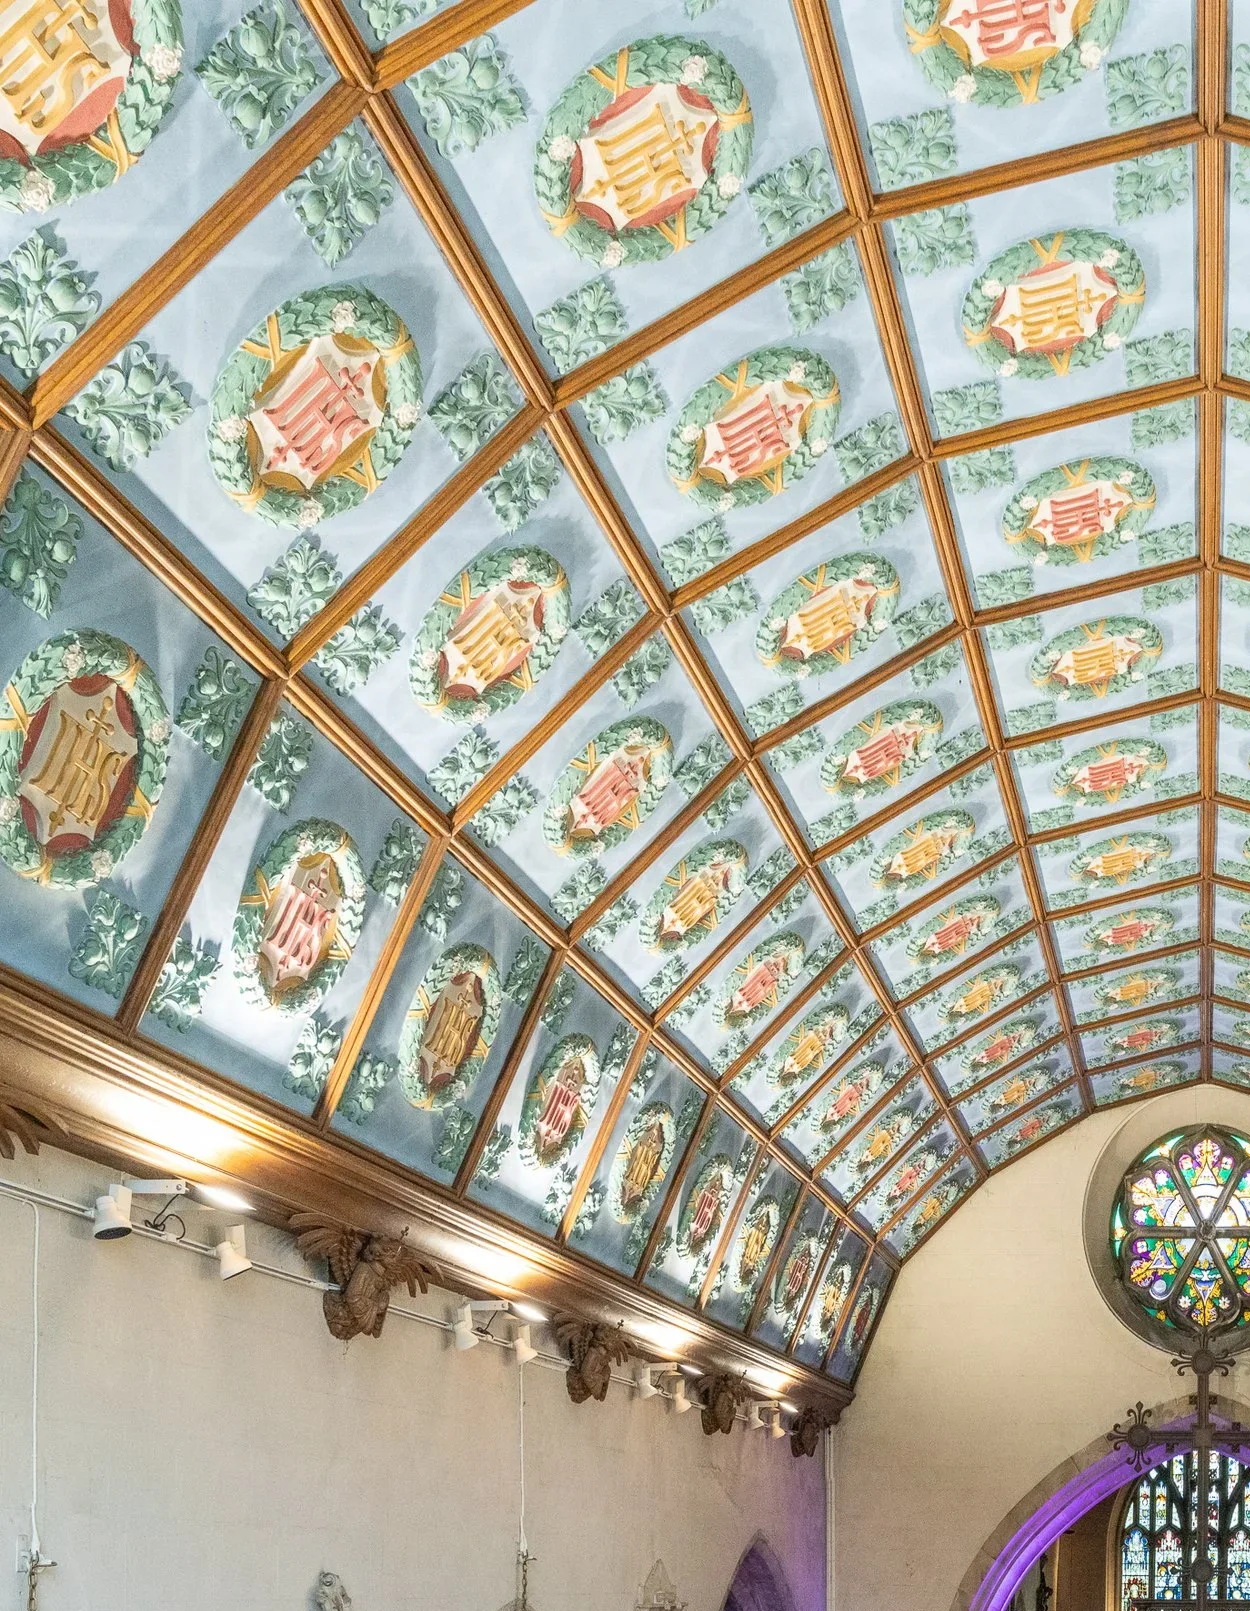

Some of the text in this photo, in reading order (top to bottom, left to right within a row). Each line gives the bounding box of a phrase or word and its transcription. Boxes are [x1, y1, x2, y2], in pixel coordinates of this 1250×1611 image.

[585, 103, 704, 214] IHS
[1006, 272, 1108, 351] IHS
[258, 355, 372, 475] IHS
[712, 393, 805, 475] IHS
[1033, 489, 1123, 542] IHS
[453, 587, 528, 682] IHS
[787, 588, 870, 650] IHS
[1058, 641, 1139, 683] IHS
[30, 697, 128, 827] IHS
[575, 753, 648, 830] IHS
[845, 729, 918, 783] IHS
[265, 870, 332, 982] IHS
[425, 985, 478, 1078] IHS
